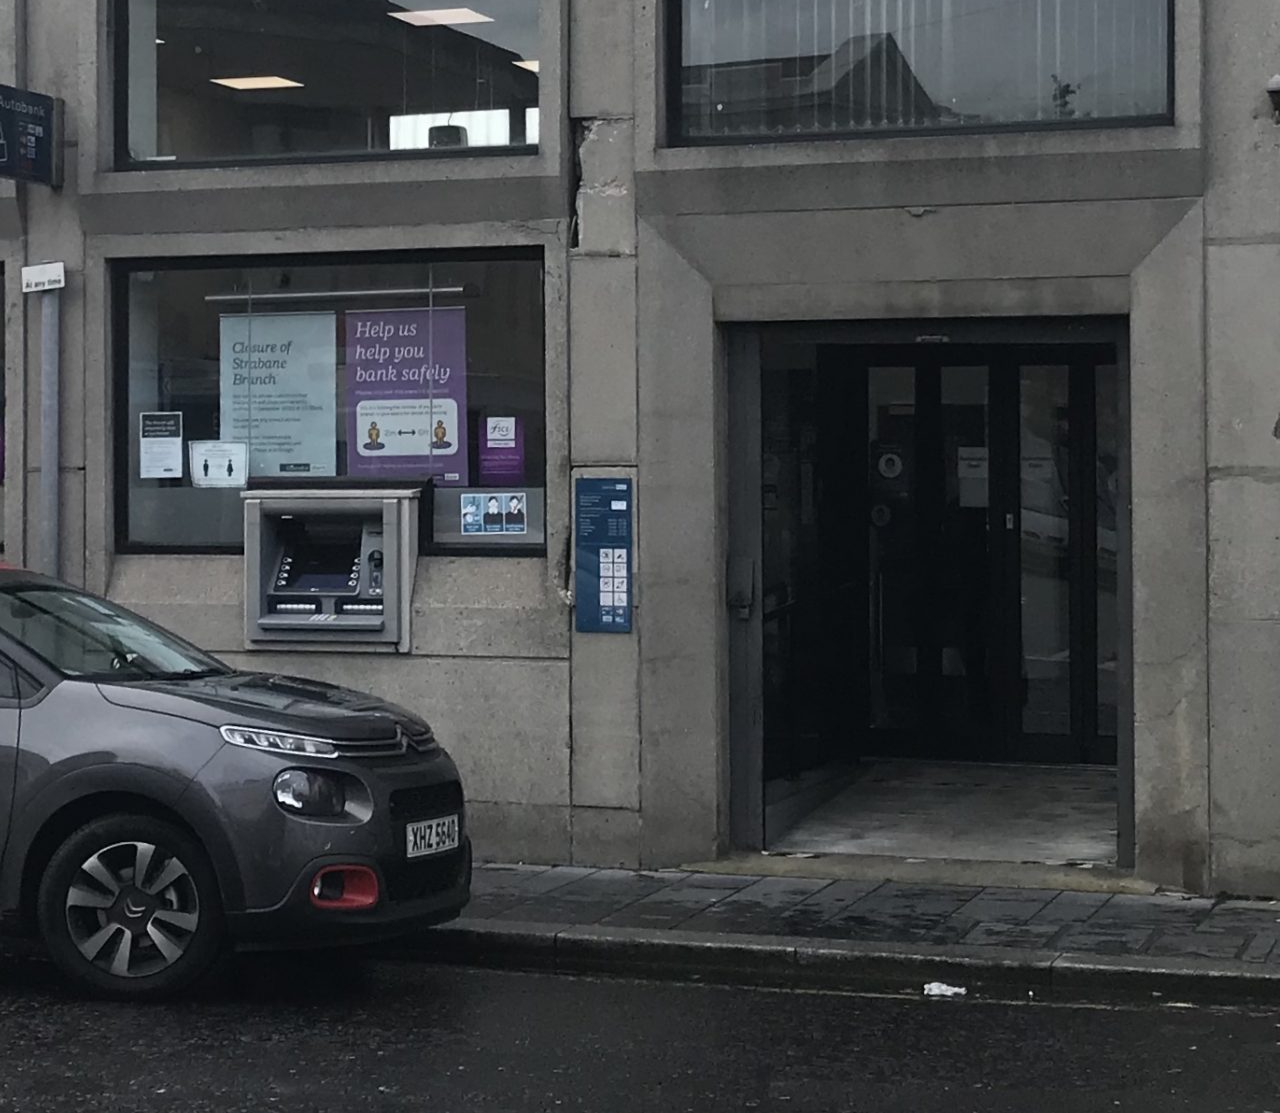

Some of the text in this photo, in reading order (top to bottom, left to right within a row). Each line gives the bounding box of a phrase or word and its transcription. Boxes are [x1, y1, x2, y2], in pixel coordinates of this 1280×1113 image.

[355, 321, 418, 341] Help us
[232, 341, 293, 355] Closure of
[355, 343, 425, 363] help you
[232, 357, 287, 370] Strabane
[232, 373, 277, 386] Branch
[355, 364, 451, 385] bank safely
[412, 824, 433, 851] XHZ
